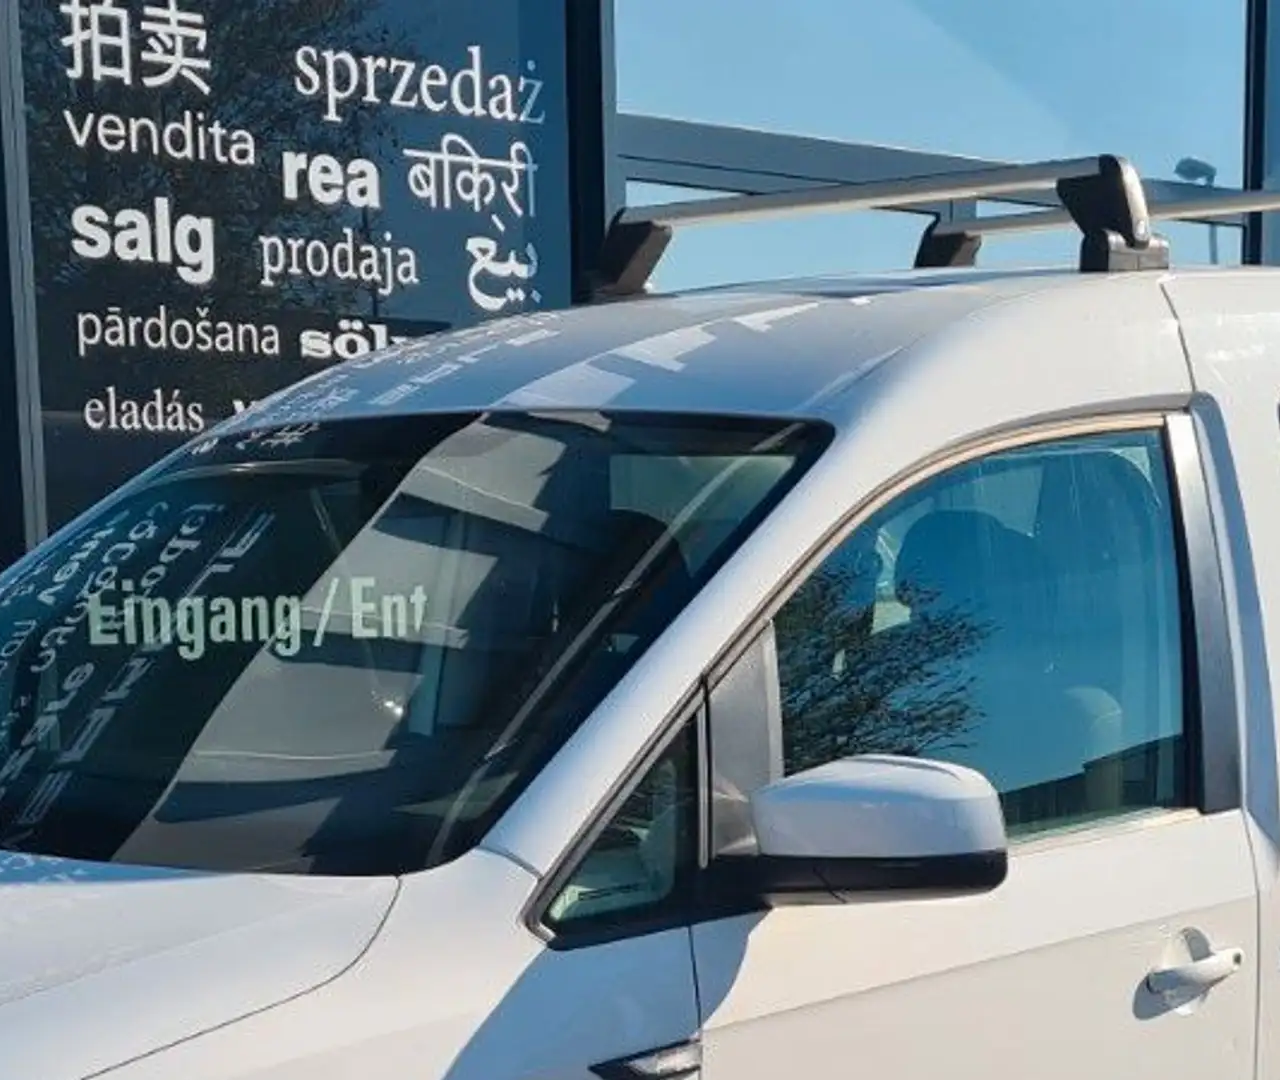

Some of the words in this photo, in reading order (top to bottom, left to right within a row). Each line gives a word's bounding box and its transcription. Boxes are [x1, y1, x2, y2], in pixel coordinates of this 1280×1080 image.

[60, 0, 211, 95] 拍卖
[295, 46, 546, 124] sprzedaż
[63, 110, 255, 166] vendita
[283, 152, 380, 208] rea
[71, 197, 215, 285] salg
[259, 228, 419, 295] prodaja
[77, 304, 280, 357] pārdošana
[301, 319, 406, 358] söl
[85, 387, 205, 432] eladás
[88, 578, 302, 661] Eingang
